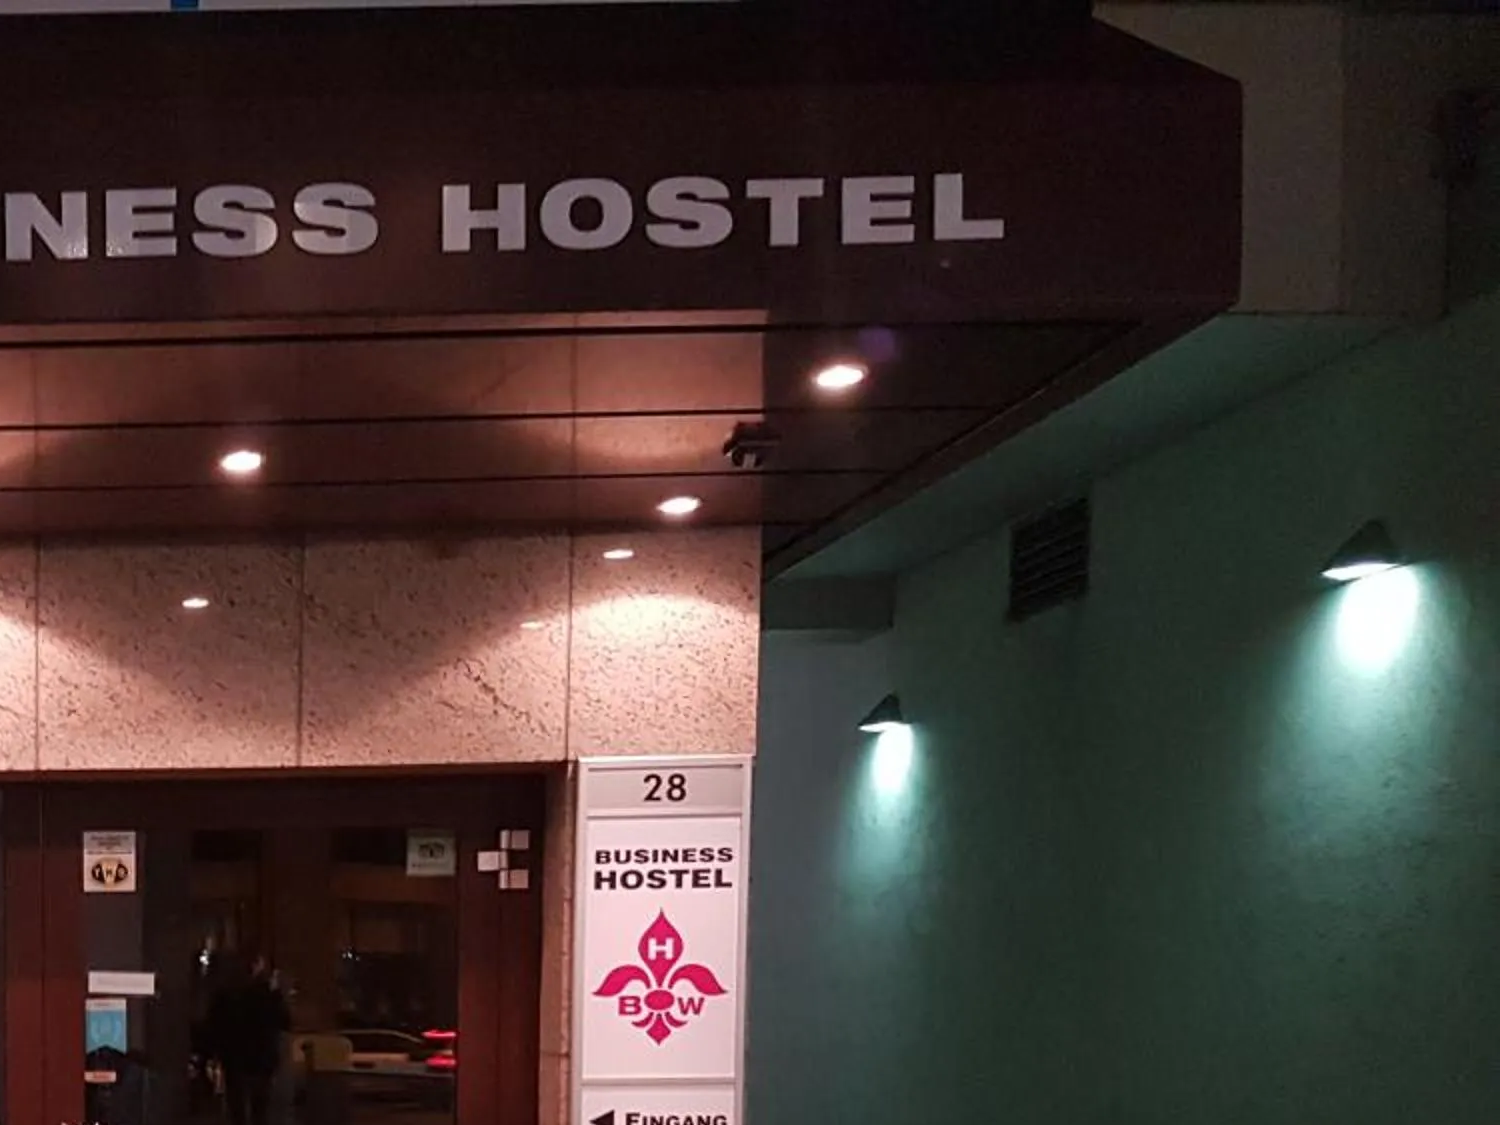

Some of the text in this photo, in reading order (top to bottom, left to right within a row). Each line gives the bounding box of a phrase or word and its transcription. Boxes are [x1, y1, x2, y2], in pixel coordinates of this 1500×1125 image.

[441, 173, 1005, 252] HOSTEL
[643, 774, 687, 801] 28
[595, 848, 734, 864] BUSINESS
[594, 869, 734, 890] HOSTEL
